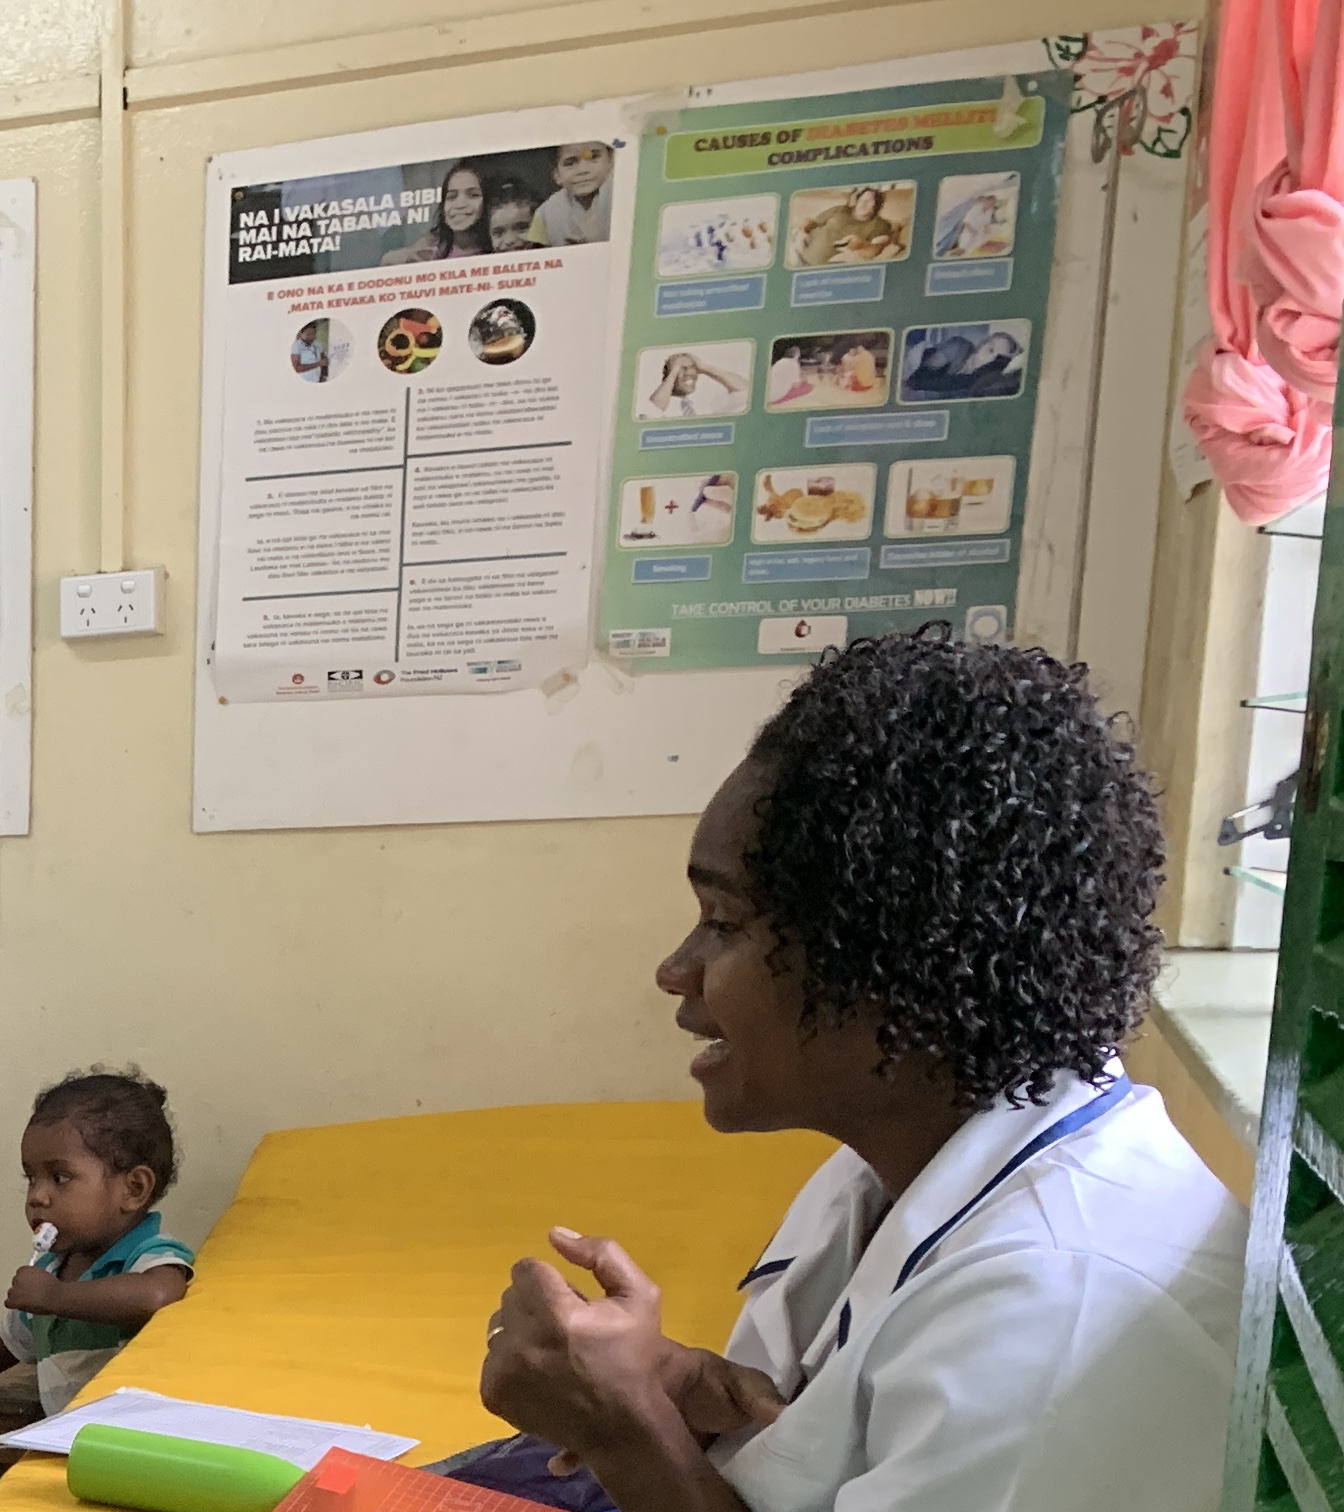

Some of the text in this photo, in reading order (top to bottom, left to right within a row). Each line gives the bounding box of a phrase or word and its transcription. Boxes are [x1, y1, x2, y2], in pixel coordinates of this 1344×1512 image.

[694, 117, 909, 153] CAUSES OF DIABETES
[767, 136, 933, 166] COMPLICATIONS
[239, 187, 443, 228] NA VAKASALA BIBI
[239, 208, 429, 246] MAI NA TABANA NI
[238, 237, 341, 262] RAI-MATA!
[277, 262, 541, 300] ONO NA KA DODONU MO KILA ME BALETA
[327, 277, 536, 309] KEVAKA KO TAUVI SUKA!
[672, 602, 706, 616] TAKE
[709, 599, 775, 615] CONTROL
[779, 599, 799, 612] OF
[802, 598, 842, 611] YOUR
[845, 594, 911, 610] DIABETES
